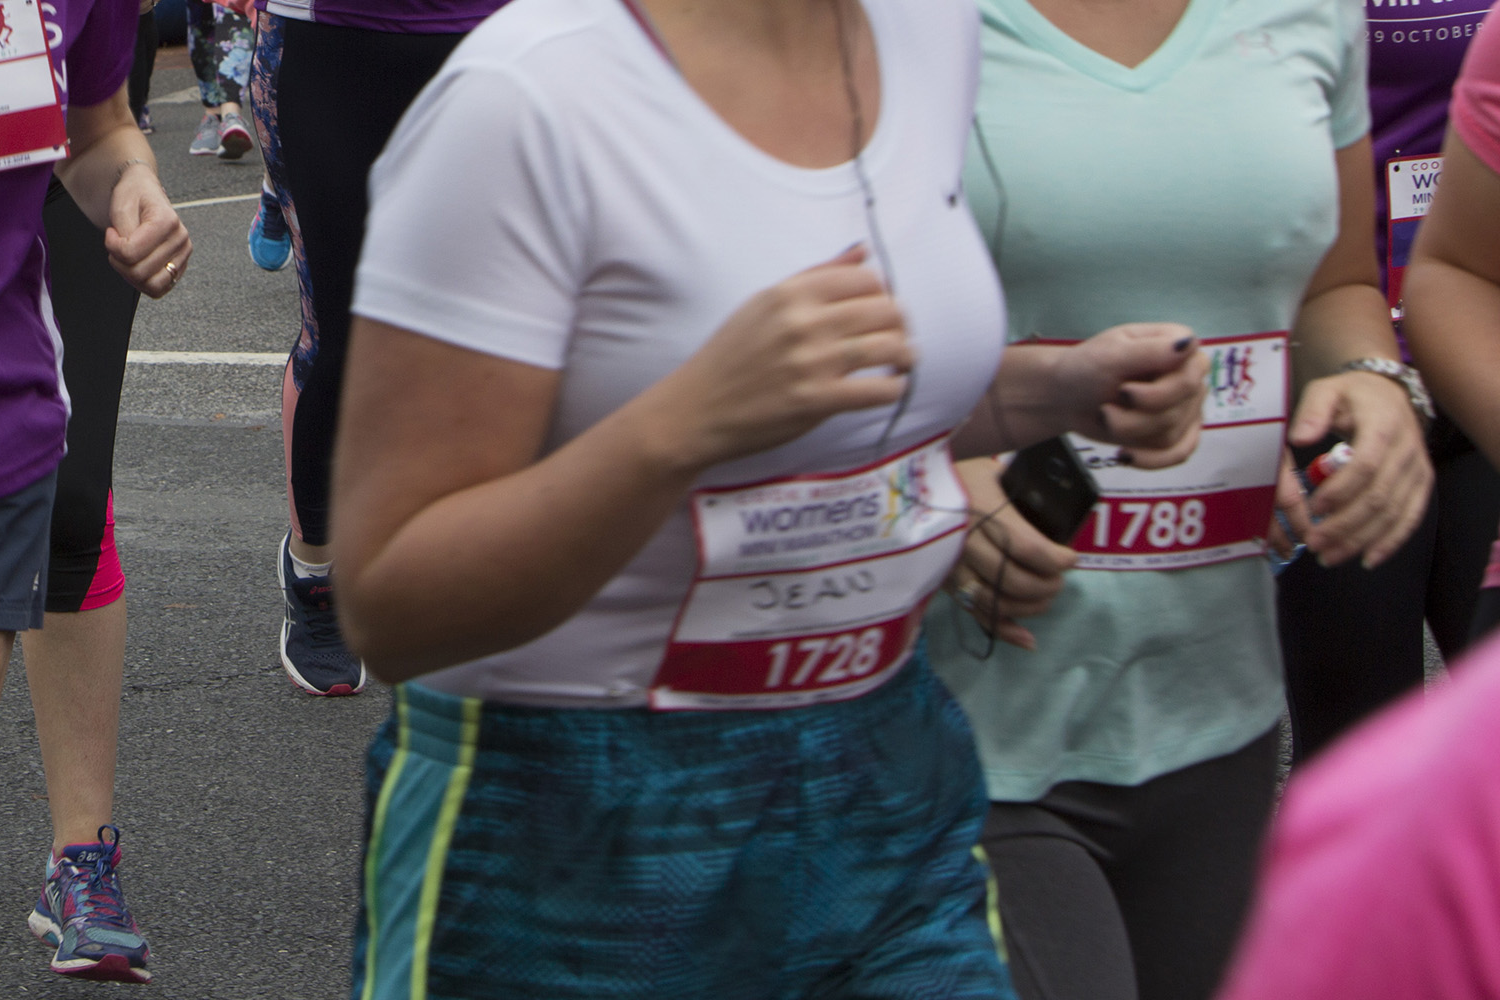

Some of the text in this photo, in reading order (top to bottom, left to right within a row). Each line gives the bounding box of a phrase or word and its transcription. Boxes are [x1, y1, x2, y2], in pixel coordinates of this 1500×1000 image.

[1411, 161, 1439, 171] COO
[739, 492, 880, 534] womens
[1092, 499, 1206, 548] 1788
[765, 627, 884, 688] 1728
